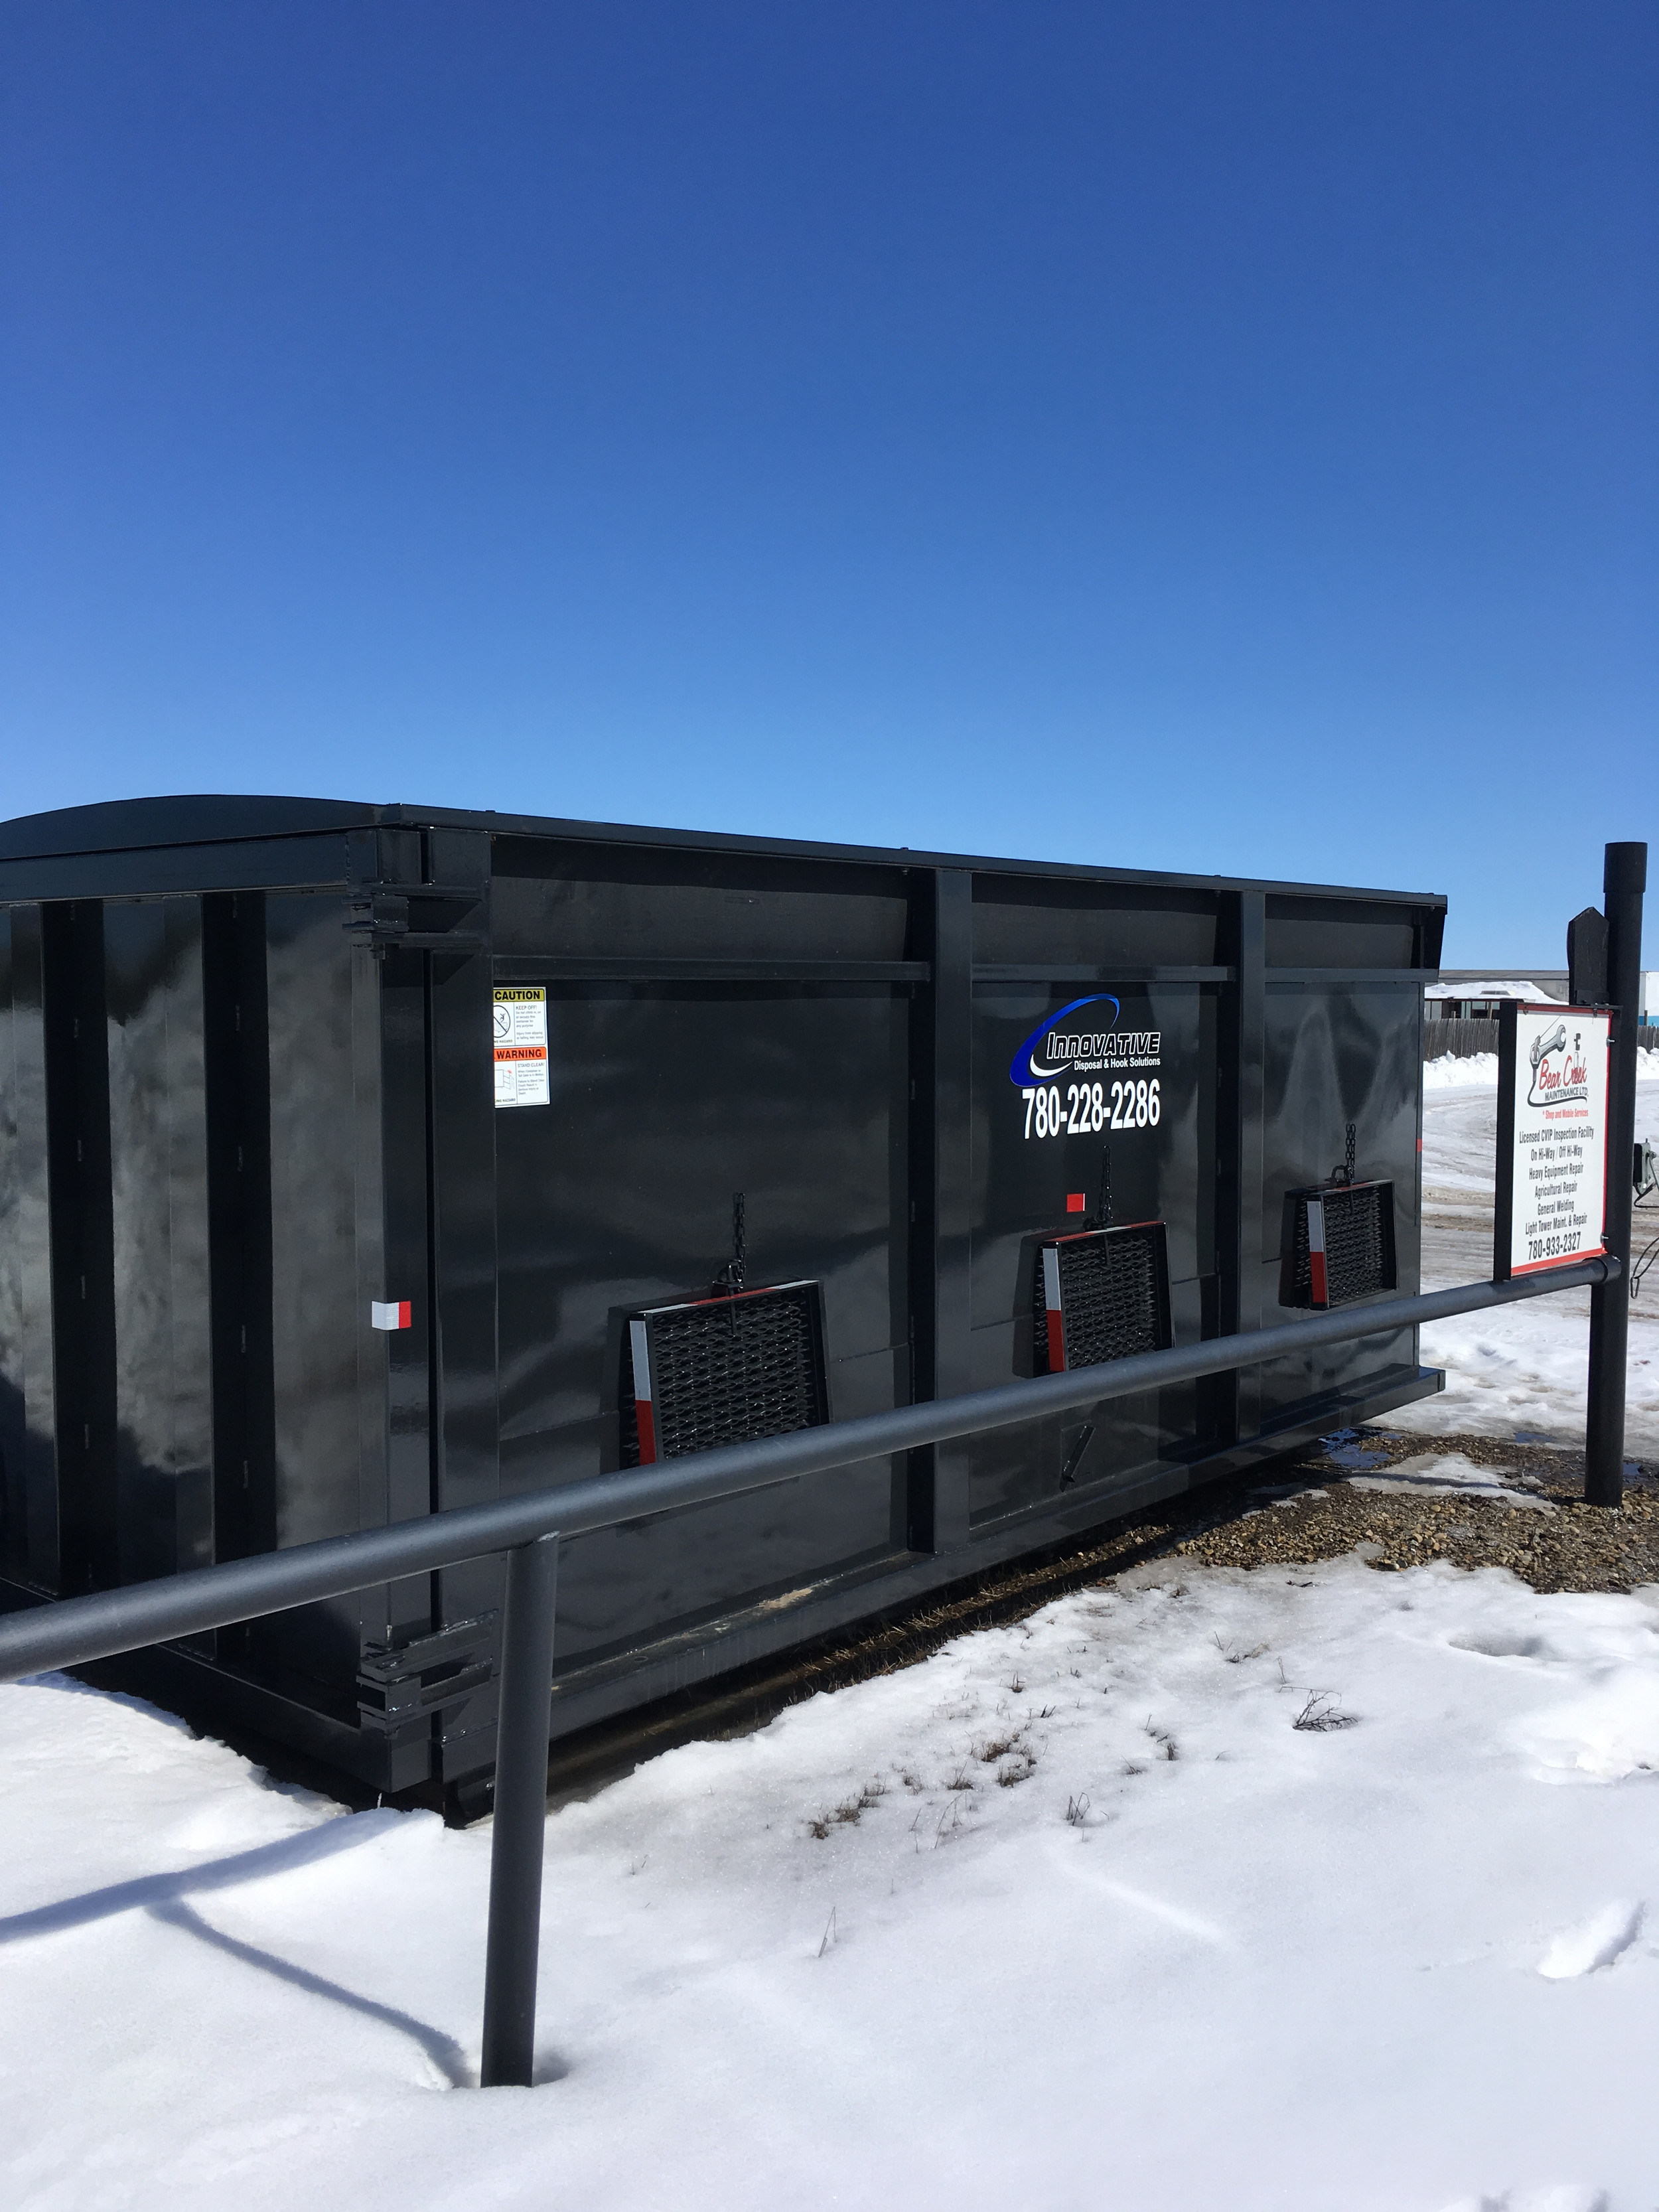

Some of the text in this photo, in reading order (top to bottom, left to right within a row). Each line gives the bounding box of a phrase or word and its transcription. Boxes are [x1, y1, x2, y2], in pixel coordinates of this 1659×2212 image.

[495, 991, 540, 1000] CAUTION
[496, 1049, 541, 1059] WARNING
[1074, 1059, 1102, 1072] Disposal
[1111, 1058, 1128, 1068] Hook
[1129, 1057, 1160, 1067] Solutions
[1539, 1055, 1587, 1090] Bear Creek
[1545, 1088, 1579, 1101] MAINTENANCE
[1022, 1078, 1160, 1139] 780-228-2286
[1546, 1110, 1554, 1120] Shop
[1563, 1109, 1573, 1118] Mobile
[1575, 1109, 1588, 1118] Services
[1519, 1126, 1594, 1144] Licensed CVIP Inspection Facility
[1531, 1149, 1538, 1161] On
[1539, 1147, 1555, 1161] Hi-Way
[1567, 1145, 1583, 1158] Hi-Way
[1529, 1163, 1583, 1181] Heavy Equipment Repair
[1535, 1181, 1577, 1199] Agricultural Repair
[1538, 1199, 1574, 1215] General Welding
[1526, 1213, 1587, 1236] Light Tower Maint. & Repair
[1528, 1232, 1581, 1260] 780-933-2327
